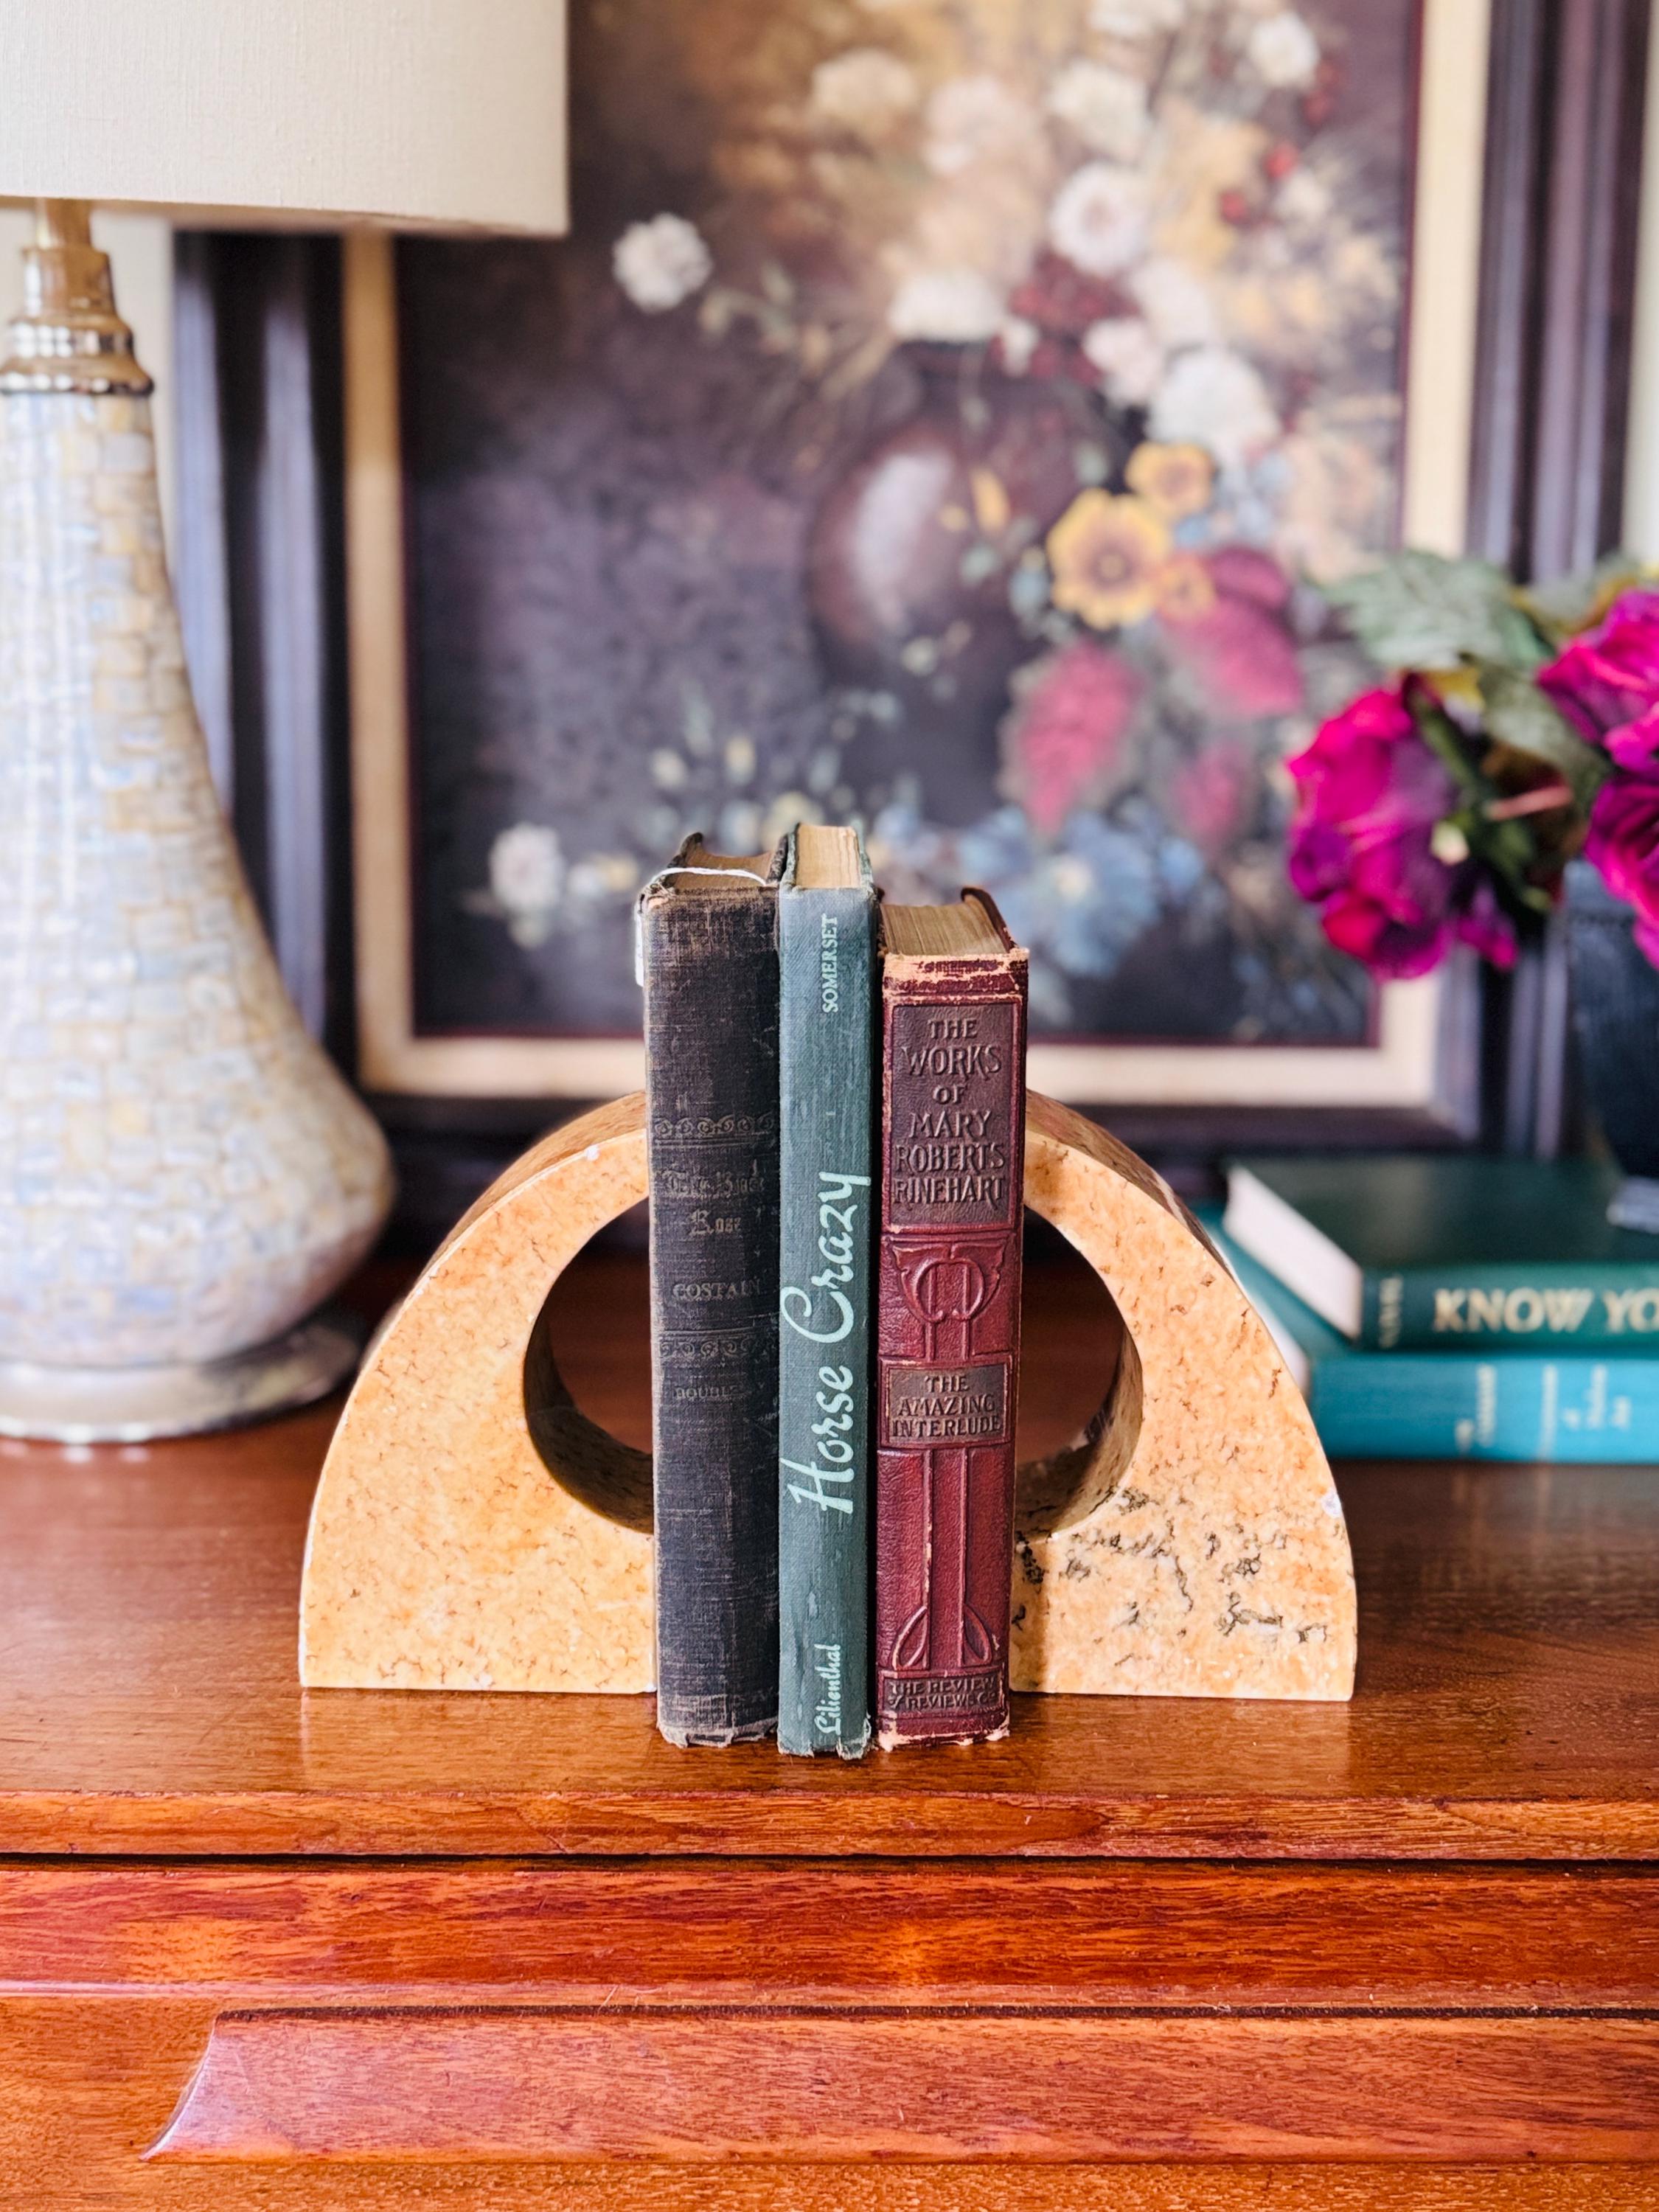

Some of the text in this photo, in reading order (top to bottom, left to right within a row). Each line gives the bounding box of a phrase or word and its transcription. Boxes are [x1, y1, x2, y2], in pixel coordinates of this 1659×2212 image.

[821, 912, 839, 1014] SOMERSET
[927, 1018, 978, 1040] THE
[900, 1044, 1003, 1082] WORKS
[931, 1082, 967, 1105] OF
[908, 1108, 992, 1139] MARY
[894, 1142, 1006, 1178] ROBERTS
[892, 1174, 1006, 1211] RINEHART
[672, 1279, 761, 1302] COSTAIN
[1433, 1287, 1595, 1334] KNOW
[779, 1171, 872, 1514] Horse Crazy
[923, 1374, 971, 1394] THE
[897, 1393, 998, 1417] AMAZING
[892, 1416, 1003, 1439] INTERLUDE
[813, 1644, 841, 1736] Lilienthal
[888, 1676, 995, 1696] THE REVIEW
